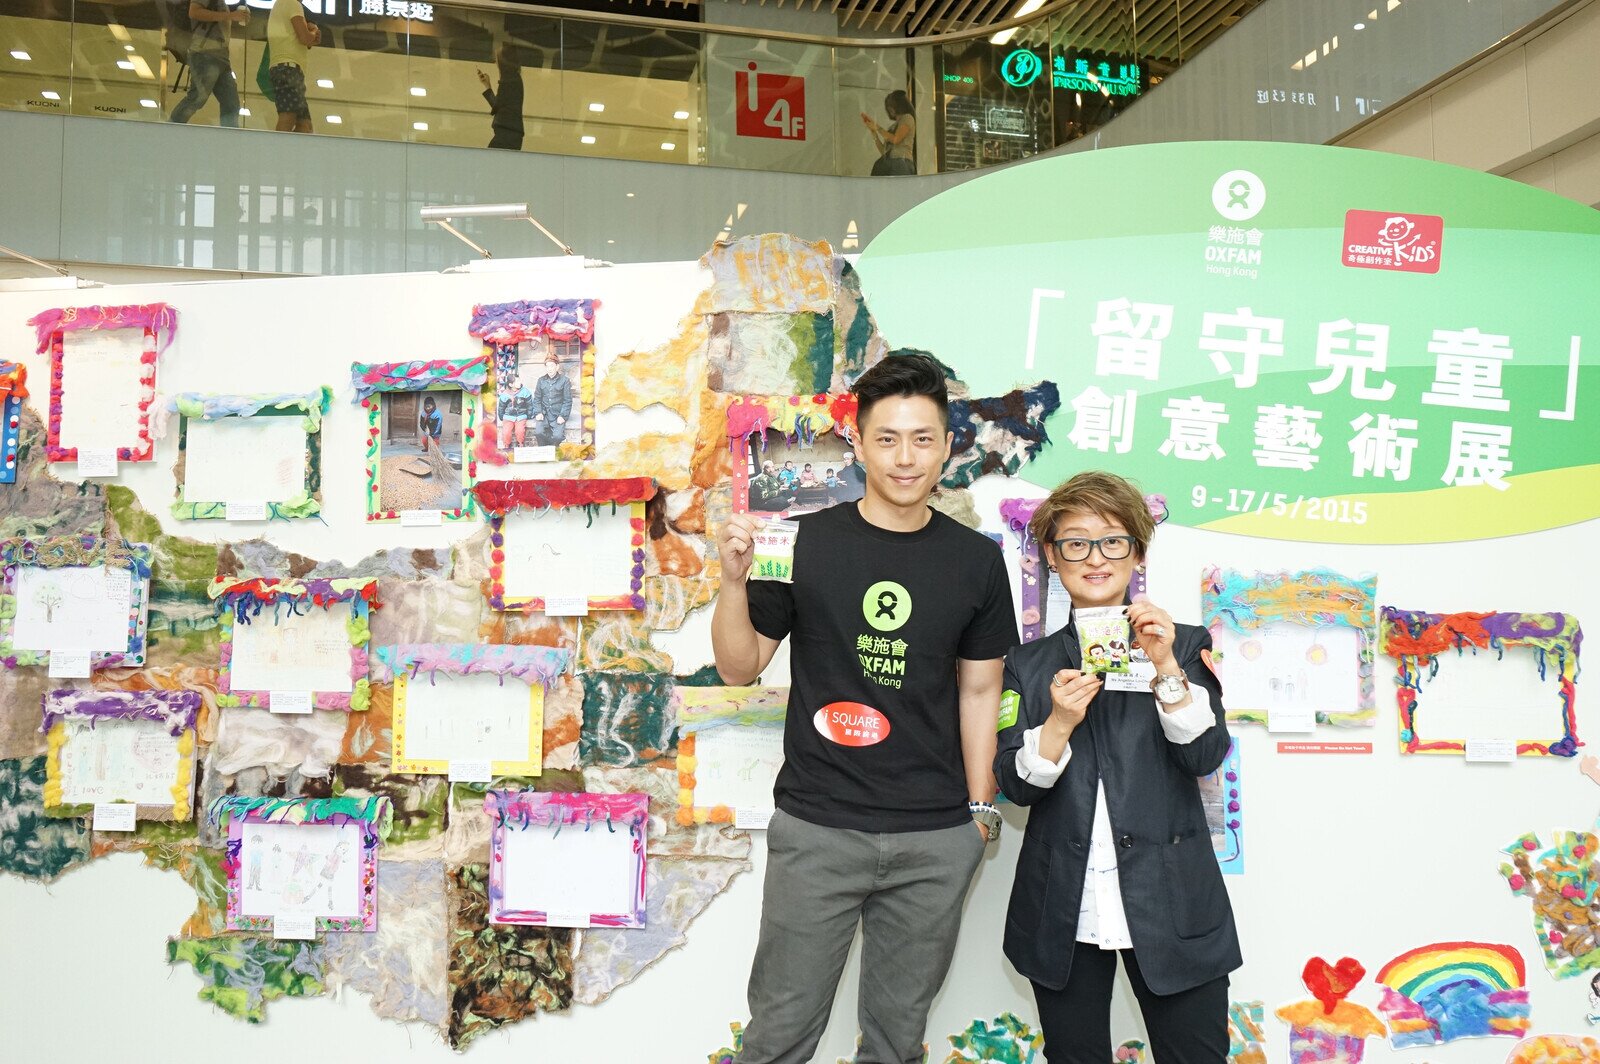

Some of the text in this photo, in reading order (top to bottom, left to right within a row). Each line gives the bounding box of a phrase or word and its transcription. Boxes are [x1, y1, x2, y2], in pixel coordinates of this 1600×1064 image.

[94, 105, 127, 113] KUONI
[764, 98, 804, 138] 4F
[1208, 224, 1264, 246] 樂施會
[1204, 245, 1262, 265] OXFAM
[1348, 244, 1393, 256] CREATIVE
[1206, 264, 1258, 280] Hong Kong
[1067, 385, 1514, 492] 創意藝術展
[856, 634, 909, 657] 樂施會
[878, 675, 902, 690] Kong
[832, 711, 881, 730] SQUARE
